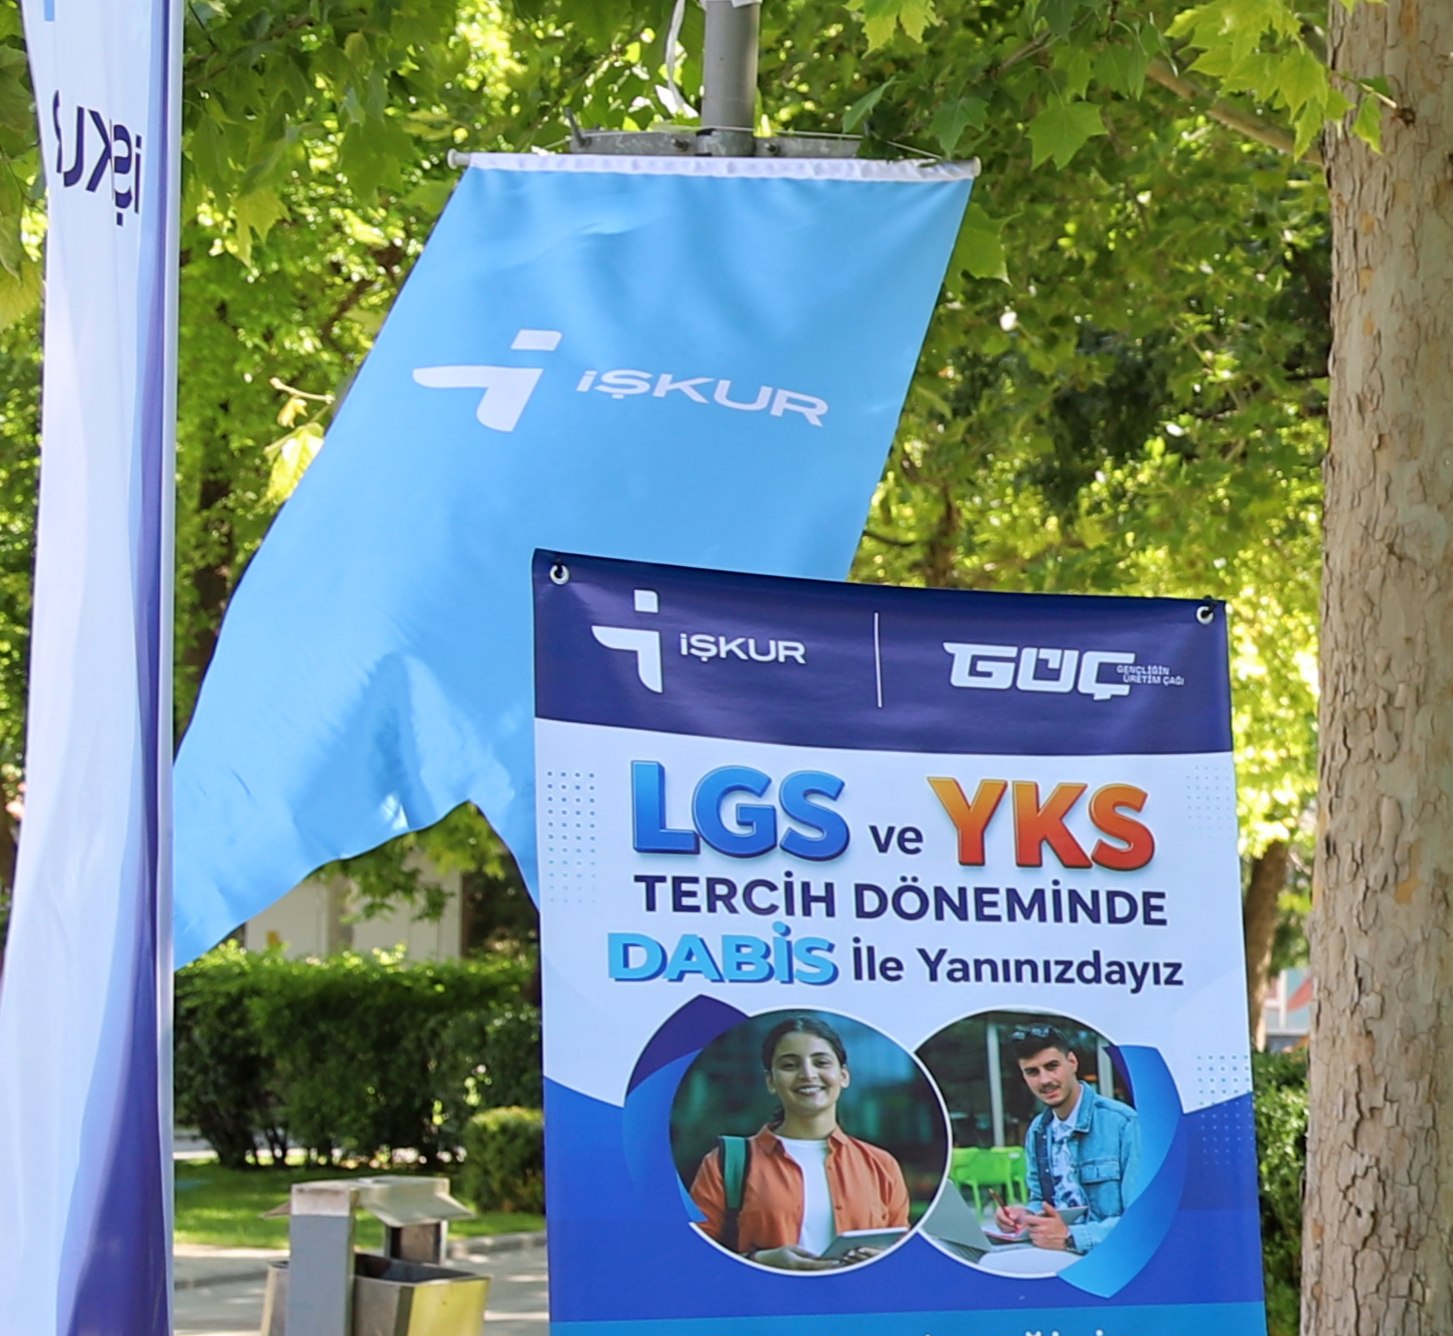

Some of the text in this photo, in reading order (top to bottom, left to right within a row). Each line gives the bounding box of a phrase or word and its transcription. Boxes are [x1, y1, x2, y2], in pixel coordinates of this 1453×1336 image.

[630, 759, 1158, 873] LGS ve YKS
[633, 870, 1168, 927] TERCİH DÖNEMİNDE
[607, 921, 1184, 995] DABİS İle Yanınızdayız
